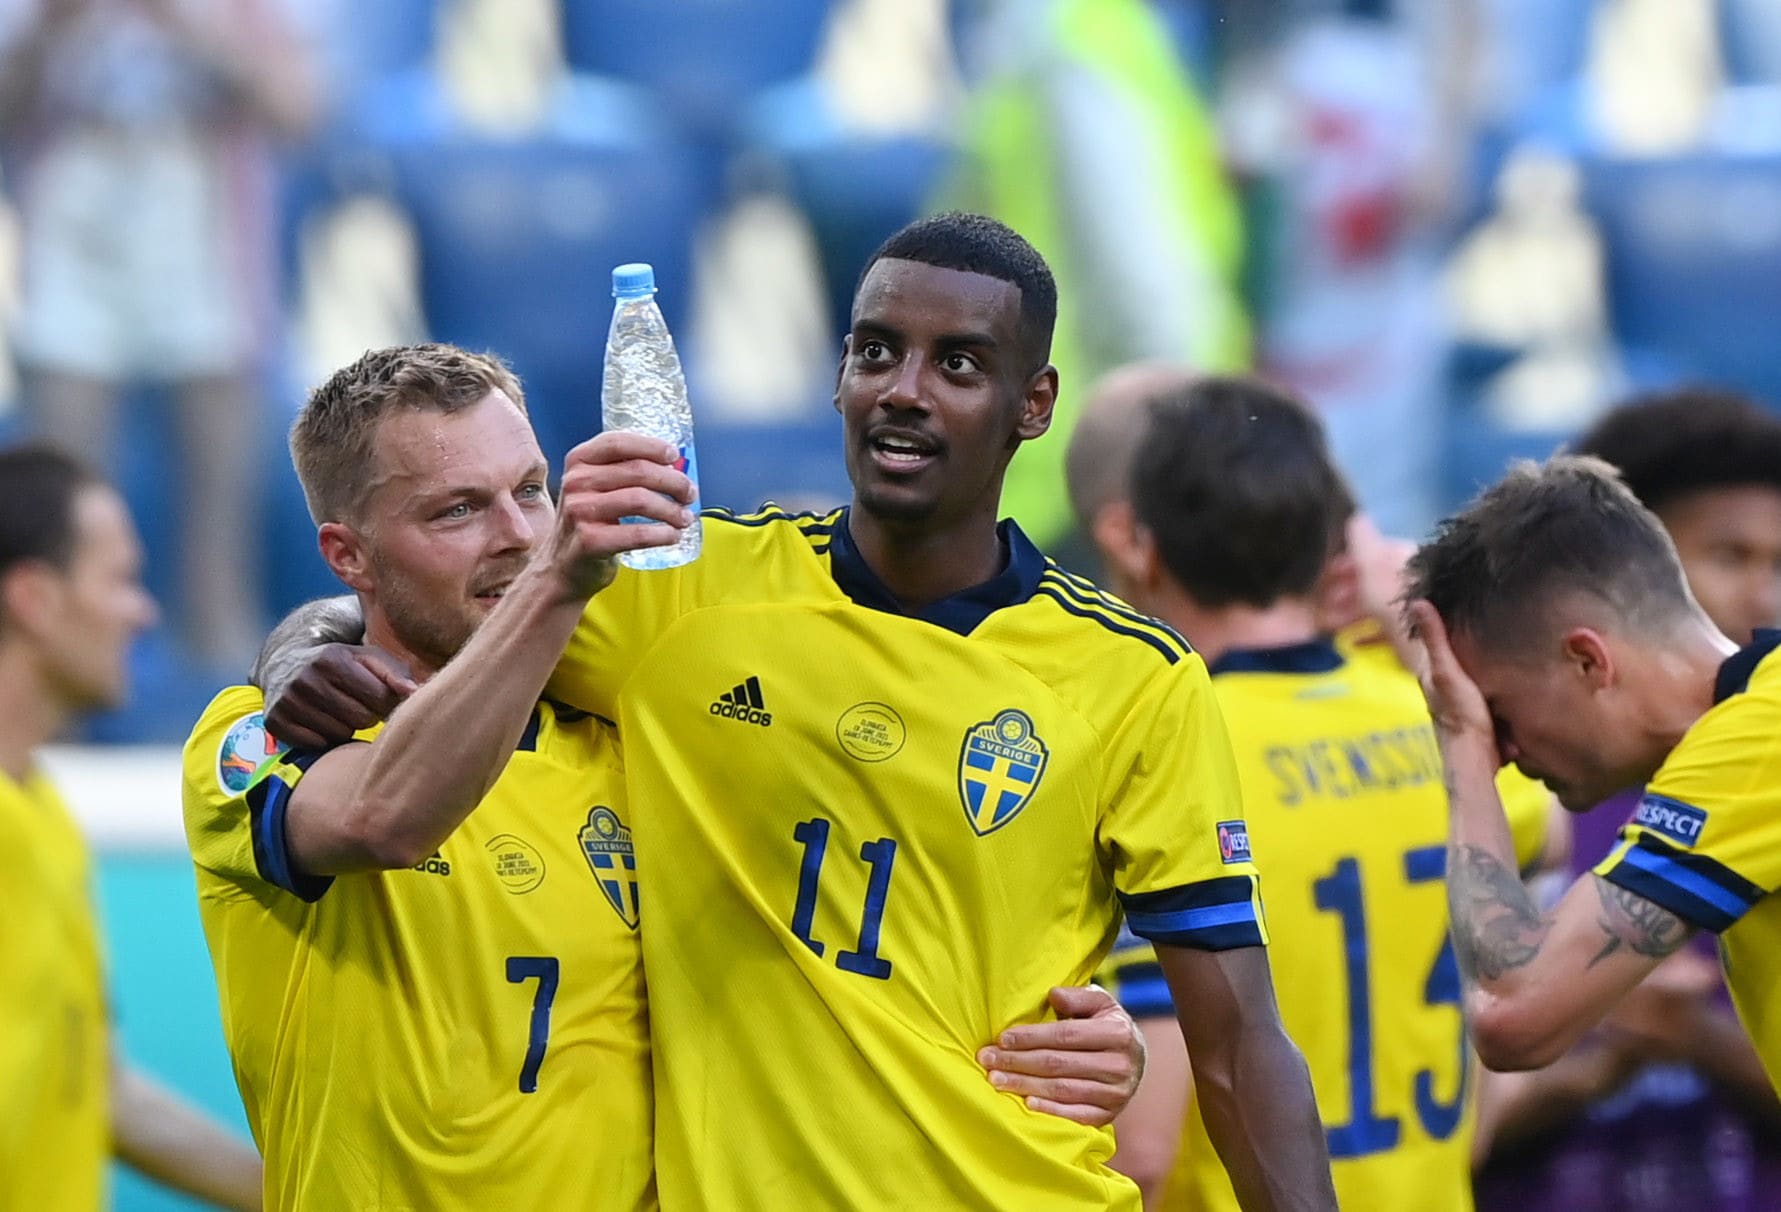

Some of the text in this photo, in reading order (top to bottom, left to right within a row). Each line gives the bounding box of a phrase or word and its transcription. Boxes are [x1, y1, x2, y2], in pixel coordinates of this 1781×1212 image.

[709, 701, 772, 727] adidas
[979, 740, 1032, 763] SVERIGE
[791, 817, 898, 980] 11
[505, 956, 560, 1094] 7
[1313, 844, 1472, 1159] 13
